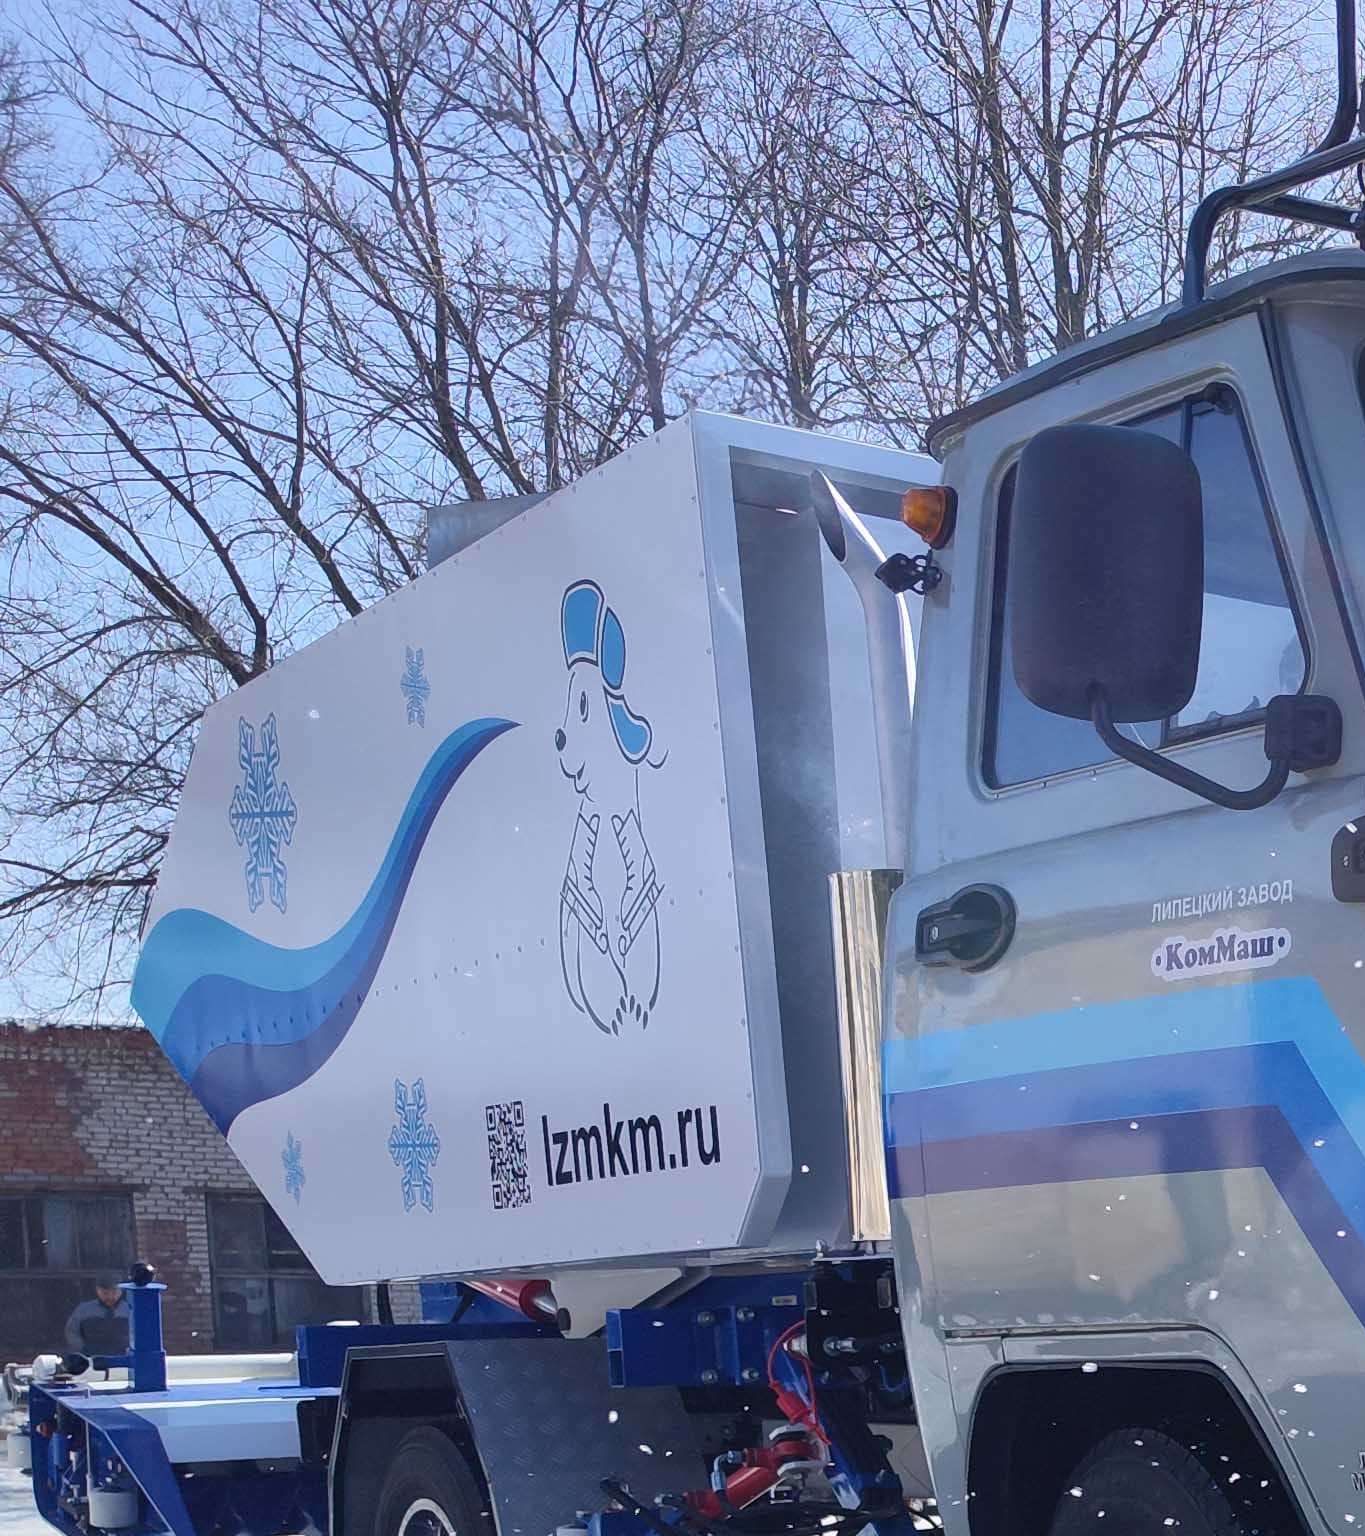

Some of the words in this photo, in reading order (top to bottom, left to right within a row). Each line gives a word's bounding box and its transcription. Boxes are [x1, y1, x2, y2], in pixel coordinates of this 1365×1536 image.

[1151, 886, 1233, 922] ЛИПЕЦКИЙ
[1237, 879, 1294, 907] ЗАВОД
[1162, 933, 1277, 972] КомМаш
[541, 1103, 721, 1187] lzmkm.ru
